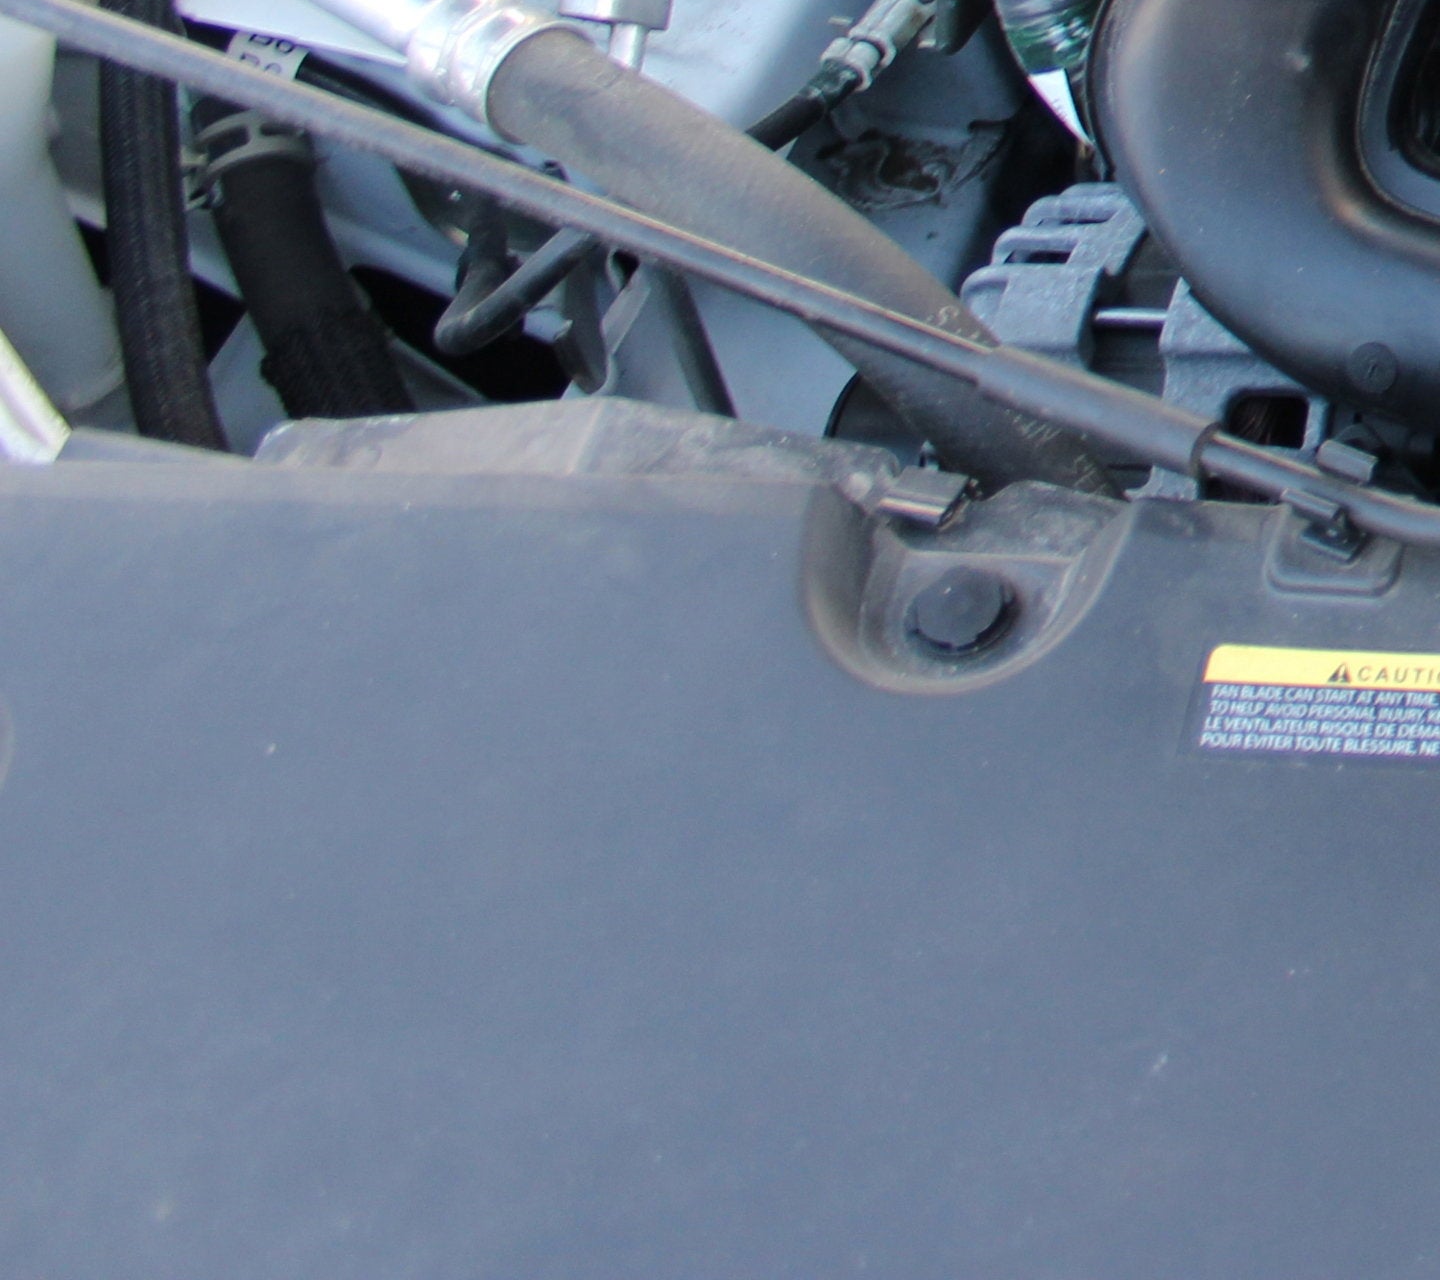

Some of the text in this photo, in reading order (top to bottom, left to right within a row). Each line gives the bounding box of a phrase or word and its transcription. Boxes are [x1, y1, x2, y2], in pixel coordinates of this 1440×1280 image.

[1211, 684, 1237, 697] FAN
[1239, 685, 1283, 700] BLADE
[1284, 687, 1314, 701] CAN
[1314, 688, 1355, 703] START
[1355, 690, 1374, 704] AT
[1374, 691, 1405, 706] ANY
[1210, 700, 1229, 714] TO
[1230, 701, 1263, 715] HELP
[1264, 702, 1307, 717] AVOID
[1308, 704, 1376, 720] PERSONAL
[1204, 716, 1223, 730] LE
[1223, 717, 1318, 734] VENTILATEUR
[1319, 721, 1374, 737] RISQUE
[1374, 723, 1397, 737] DE
[1200, 732, 1244, 747] POUR
[1294, 735, 1342, 751] TOUTE
[1418, 741, 1440, 757] NE
